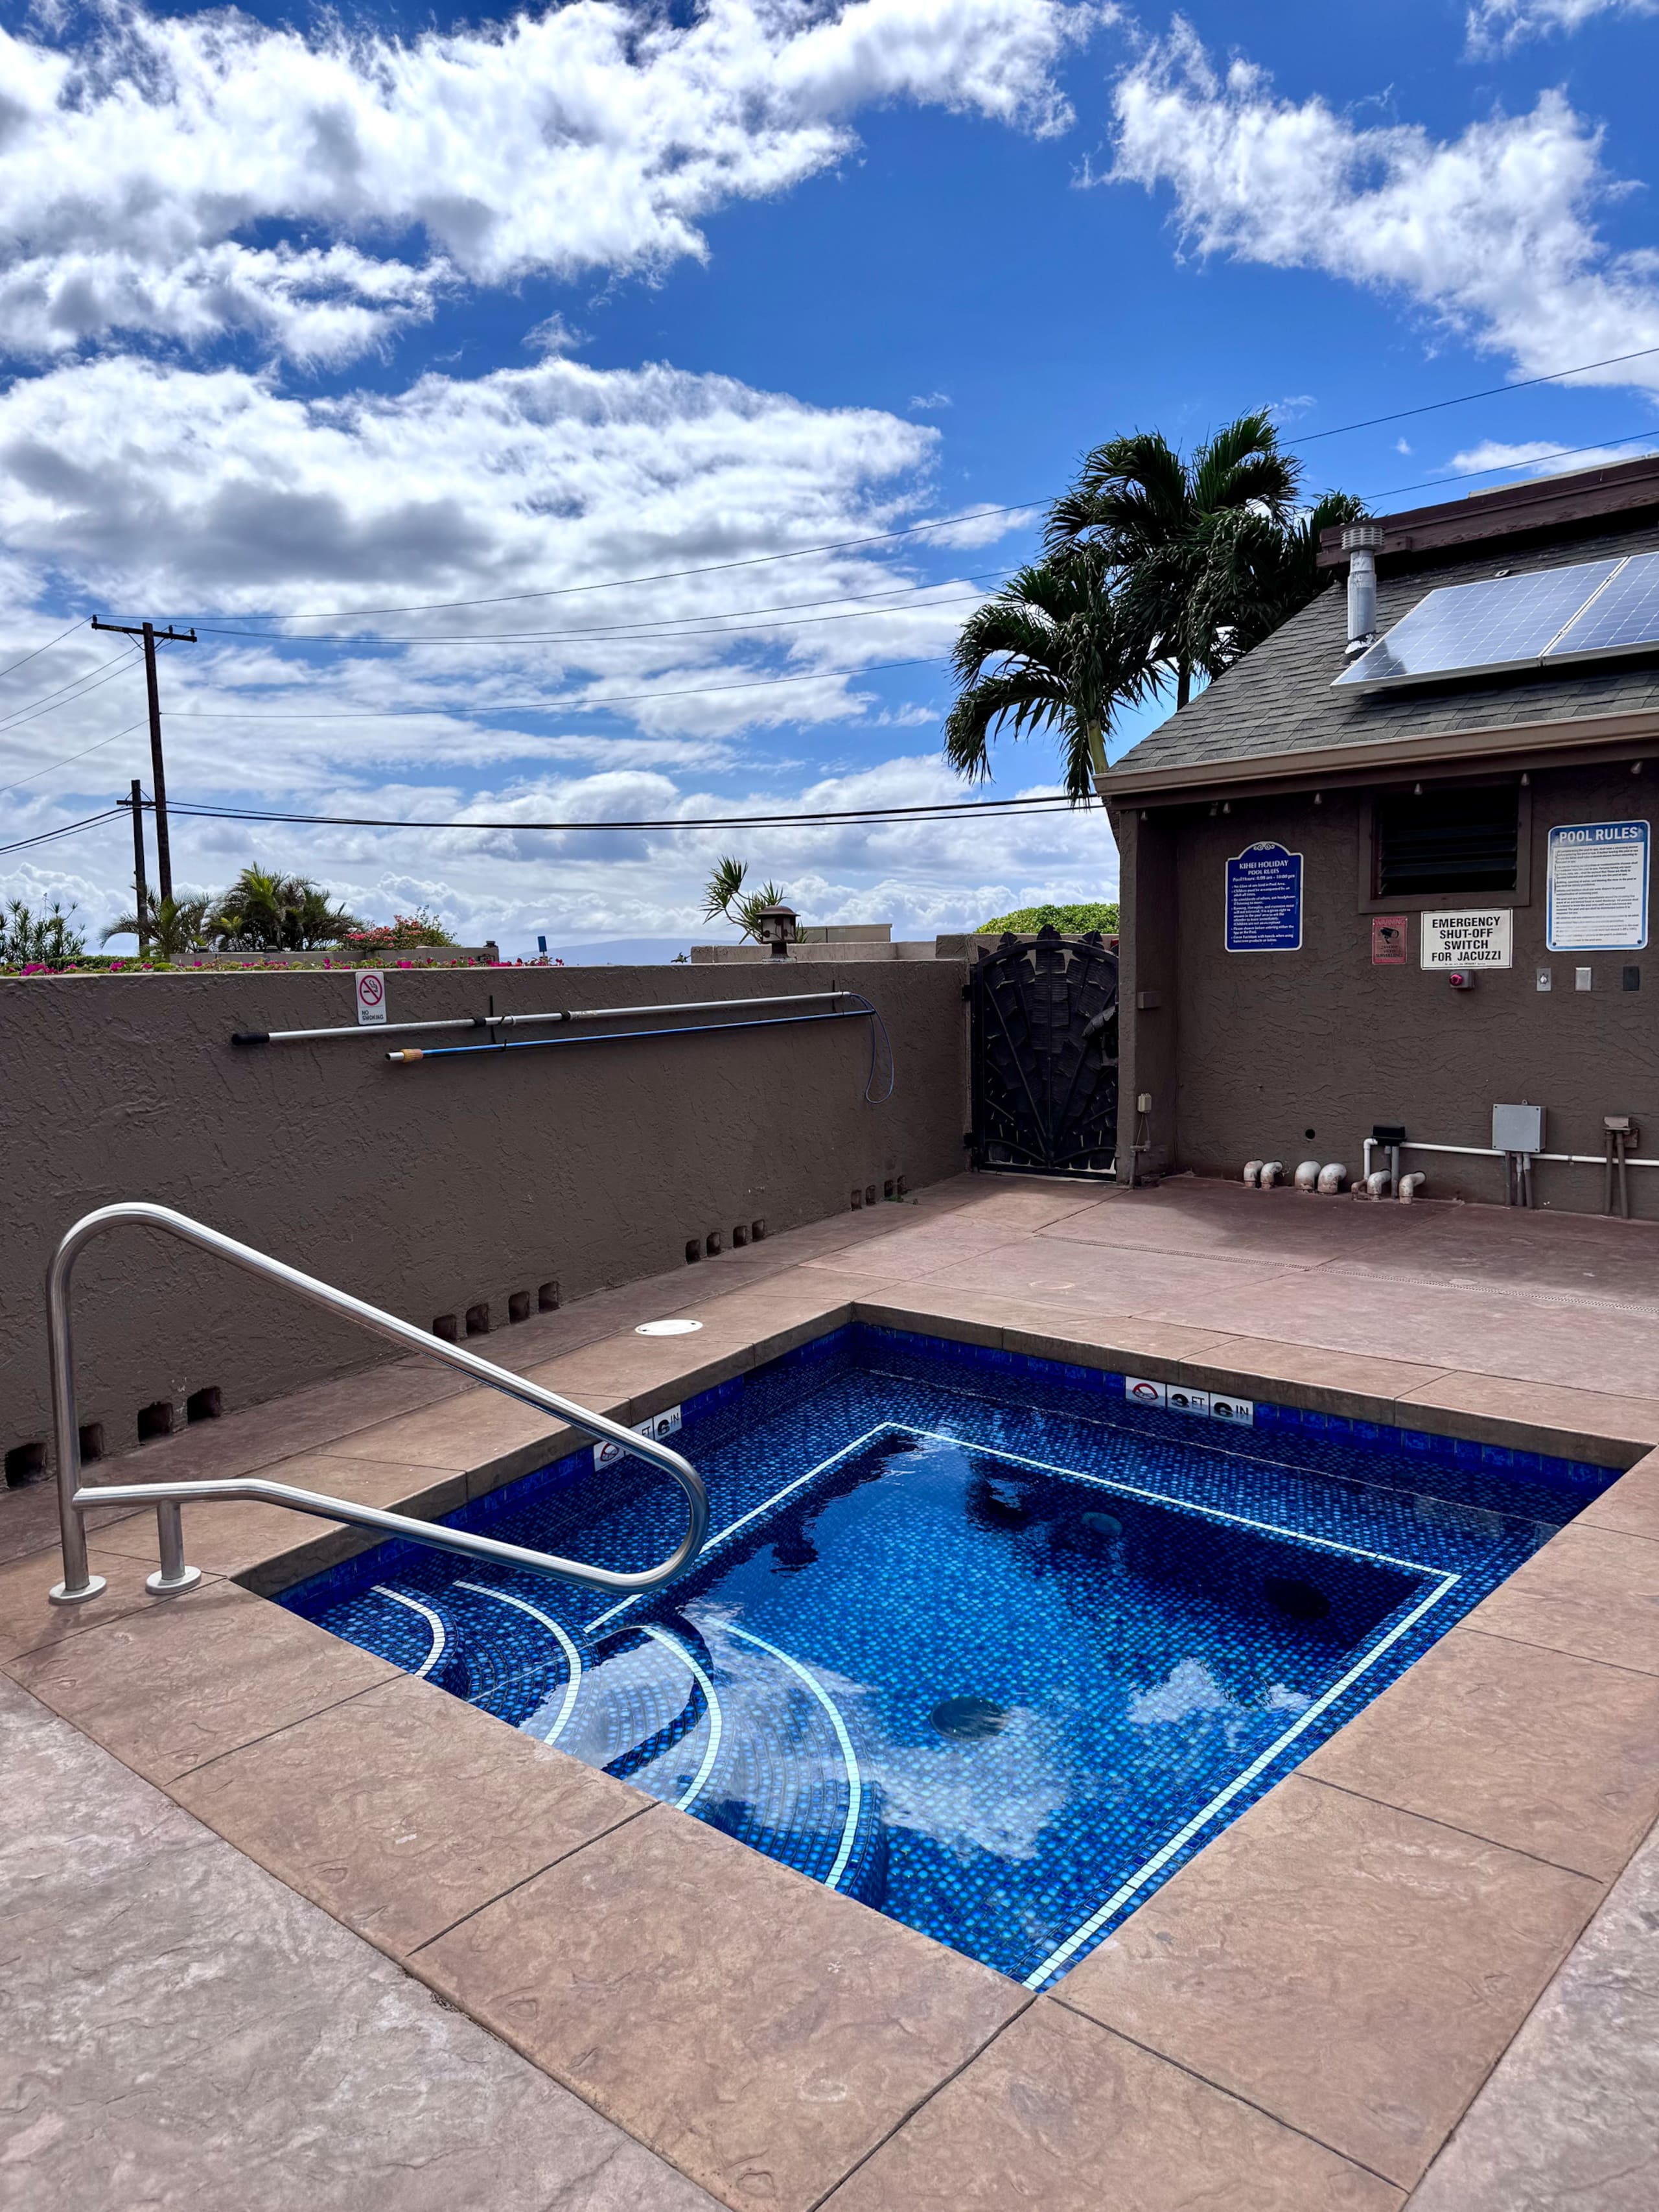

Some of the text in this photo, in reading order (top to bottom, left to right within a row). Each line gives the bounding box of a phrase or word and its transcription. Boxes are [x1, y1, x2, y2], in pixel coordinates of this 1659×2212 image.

[1559, 827, 1638, 843] POOL RULES
[1432, 916, 1500, 928] EMERGENCY
[1439, 928, 1494, 939] SHUT-OFF
[1444, 940, 1489, 950] SWITCH
[1432, 951, 1501, 962] FOR JACUZZI
[1191, 1396, 1205, 1406] FT
[1236, 1404, 1249, 1415] IN
[642, 1413, 679, 1436] FT 6 IN
